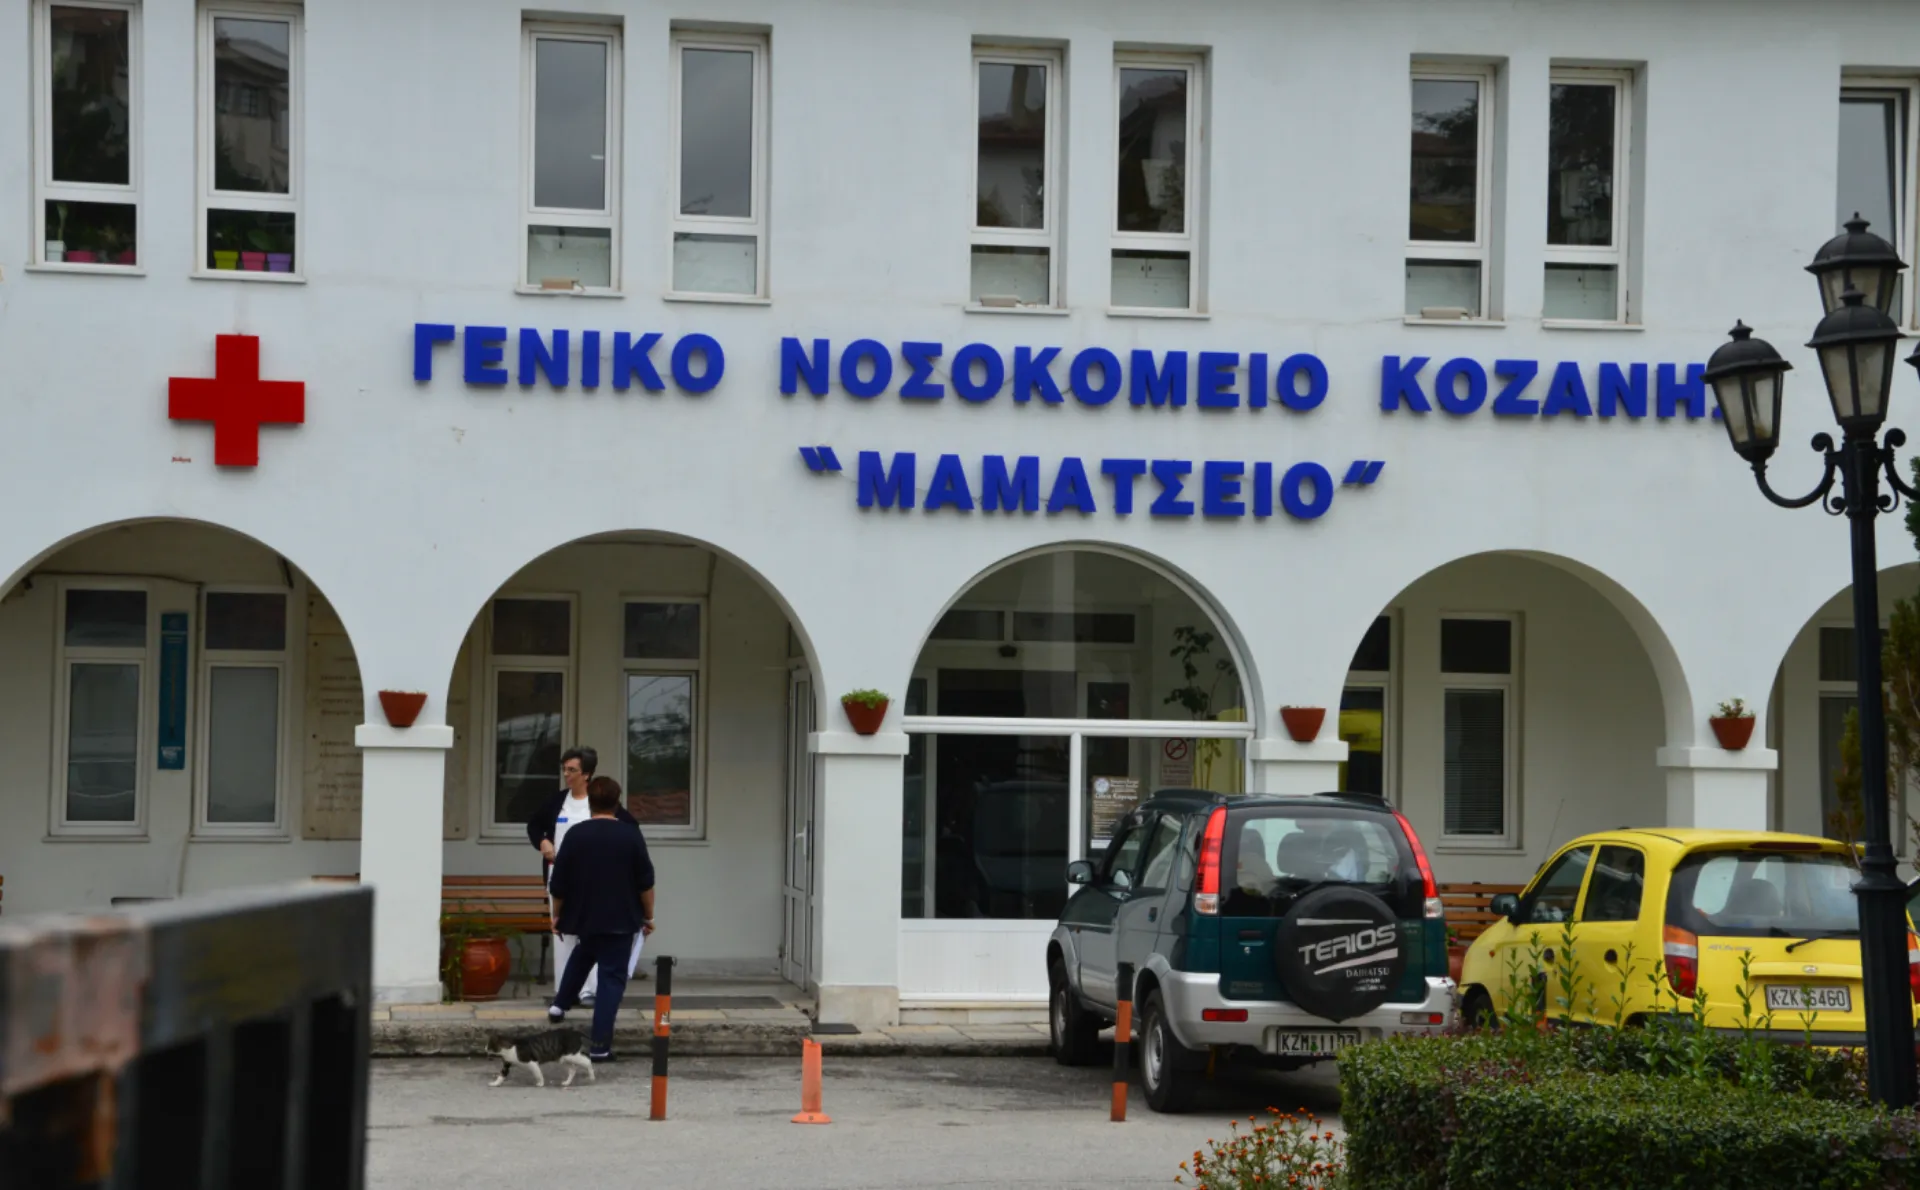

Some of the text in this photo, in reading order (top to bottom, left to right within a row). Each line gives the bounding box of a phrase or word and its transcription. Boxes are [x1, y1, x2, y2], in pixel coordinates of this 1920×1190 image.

[414, 323, 1722, 419] ΓΕΝΙΚΟ ΝΟΣΟΚΟΜΕΙΟ ΚΟΖΑΝΗ
[1298, 923, 1396, 966] TERIOS
